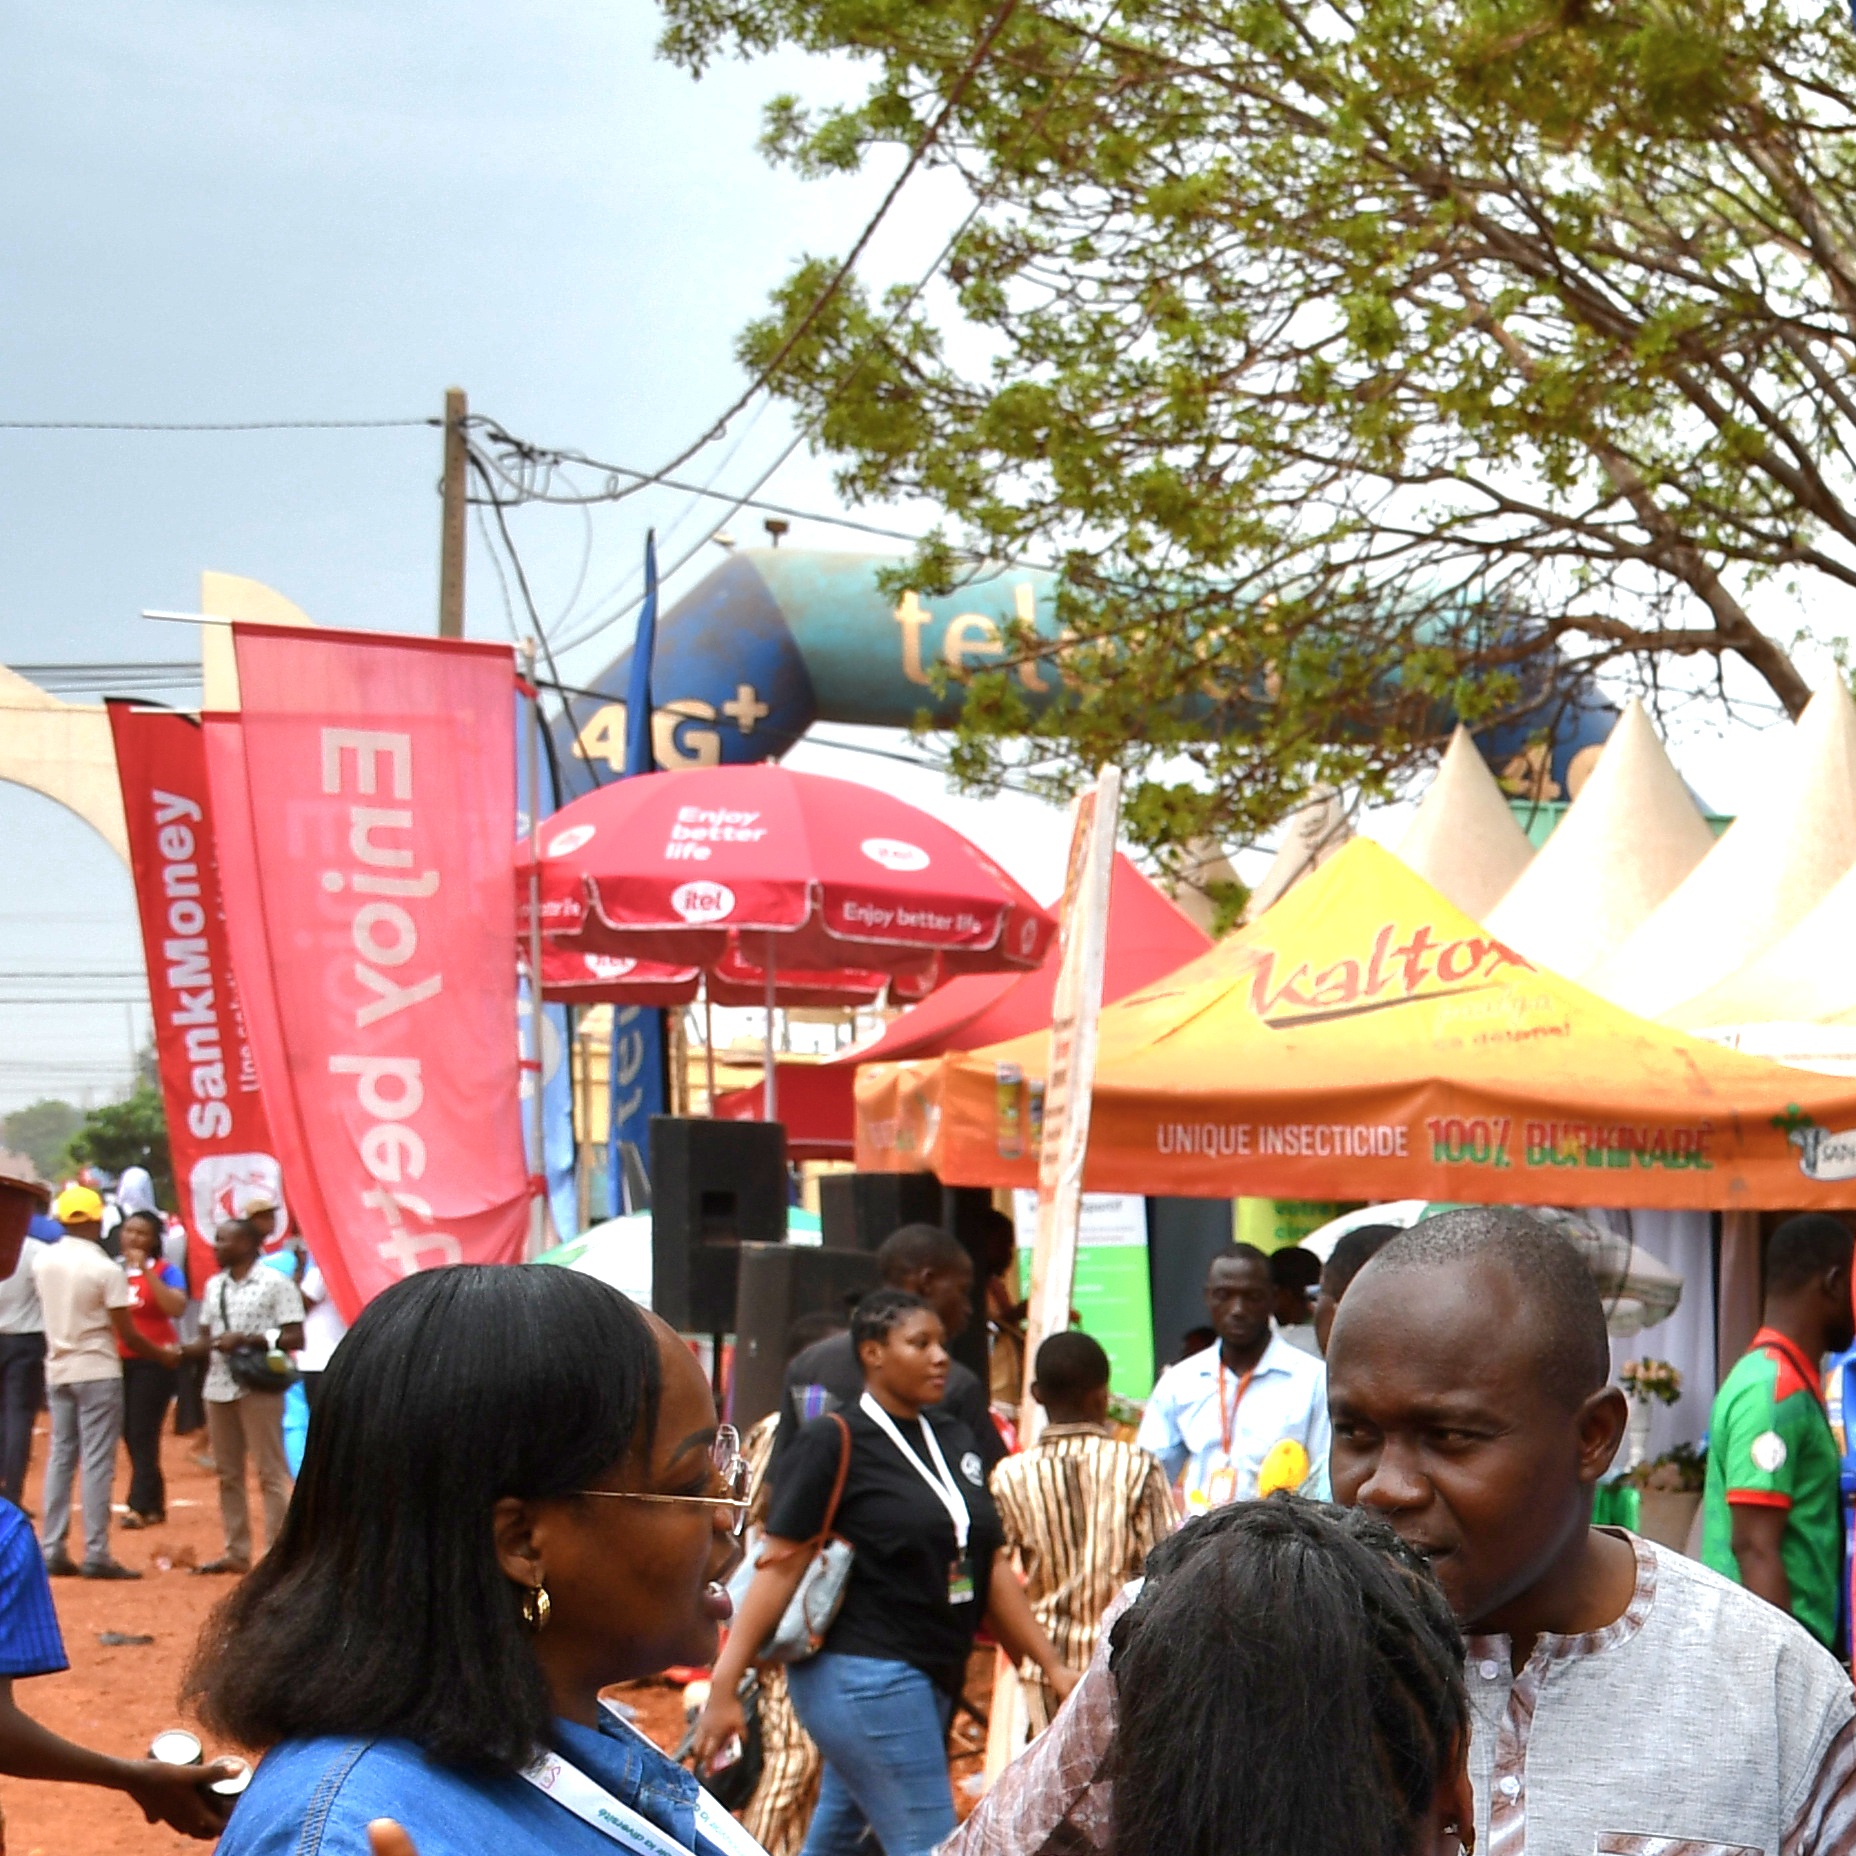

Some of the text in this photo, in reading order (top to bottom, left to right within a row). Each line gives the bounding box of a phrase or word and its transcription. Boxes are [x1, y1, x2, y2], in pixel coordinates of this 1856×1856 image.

[678, 806, 761, 827] Enjoy
[671, 825, 768, 843] better
[664, 842, 712, 860] life
[680, 888, 723, 912] itel
[843, 902, 982, 934] Enjoy better life
[152, 789, 233, 1140] SankMoney
[1157, 1123, 1251, 1157] UNIQUE
[1258, 1125, 1409, 1159] INSECTICIDE
[1427, 1116, 1513, 1168] 100%
[643, 1838, 657, 1852] la
